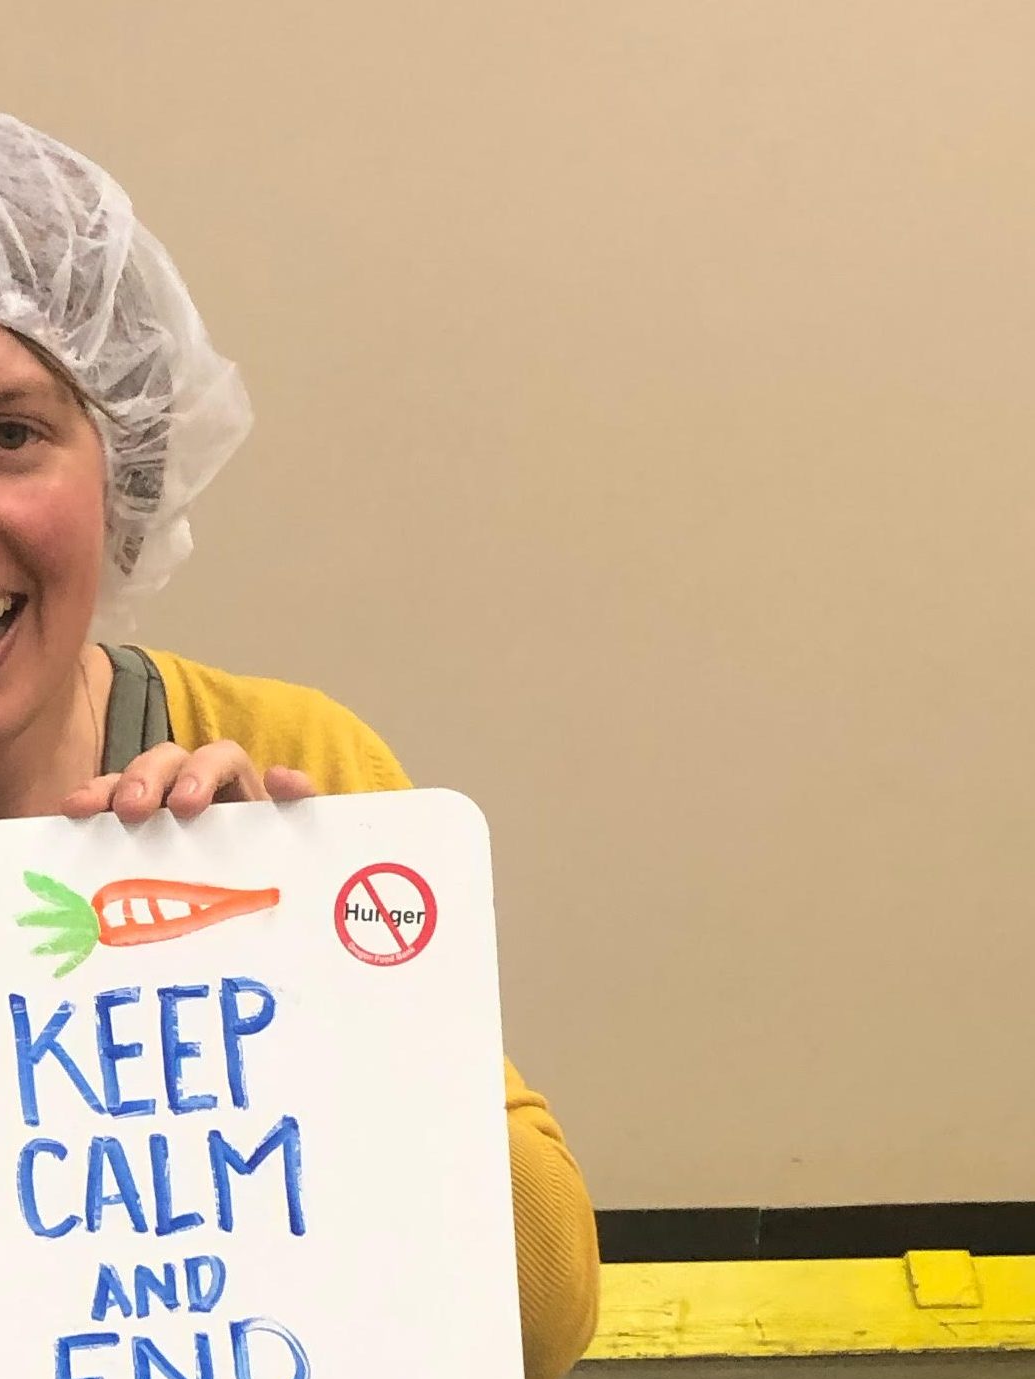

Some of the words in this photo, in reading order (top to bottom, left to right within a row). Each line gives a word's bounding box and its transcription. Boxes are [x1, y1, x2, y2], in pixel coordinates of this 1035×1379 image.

[9, 976, 277, 1127] KEEP
[17, 1115, 307, 1239] CALM
[91, 1255, 227, 1321] AND
